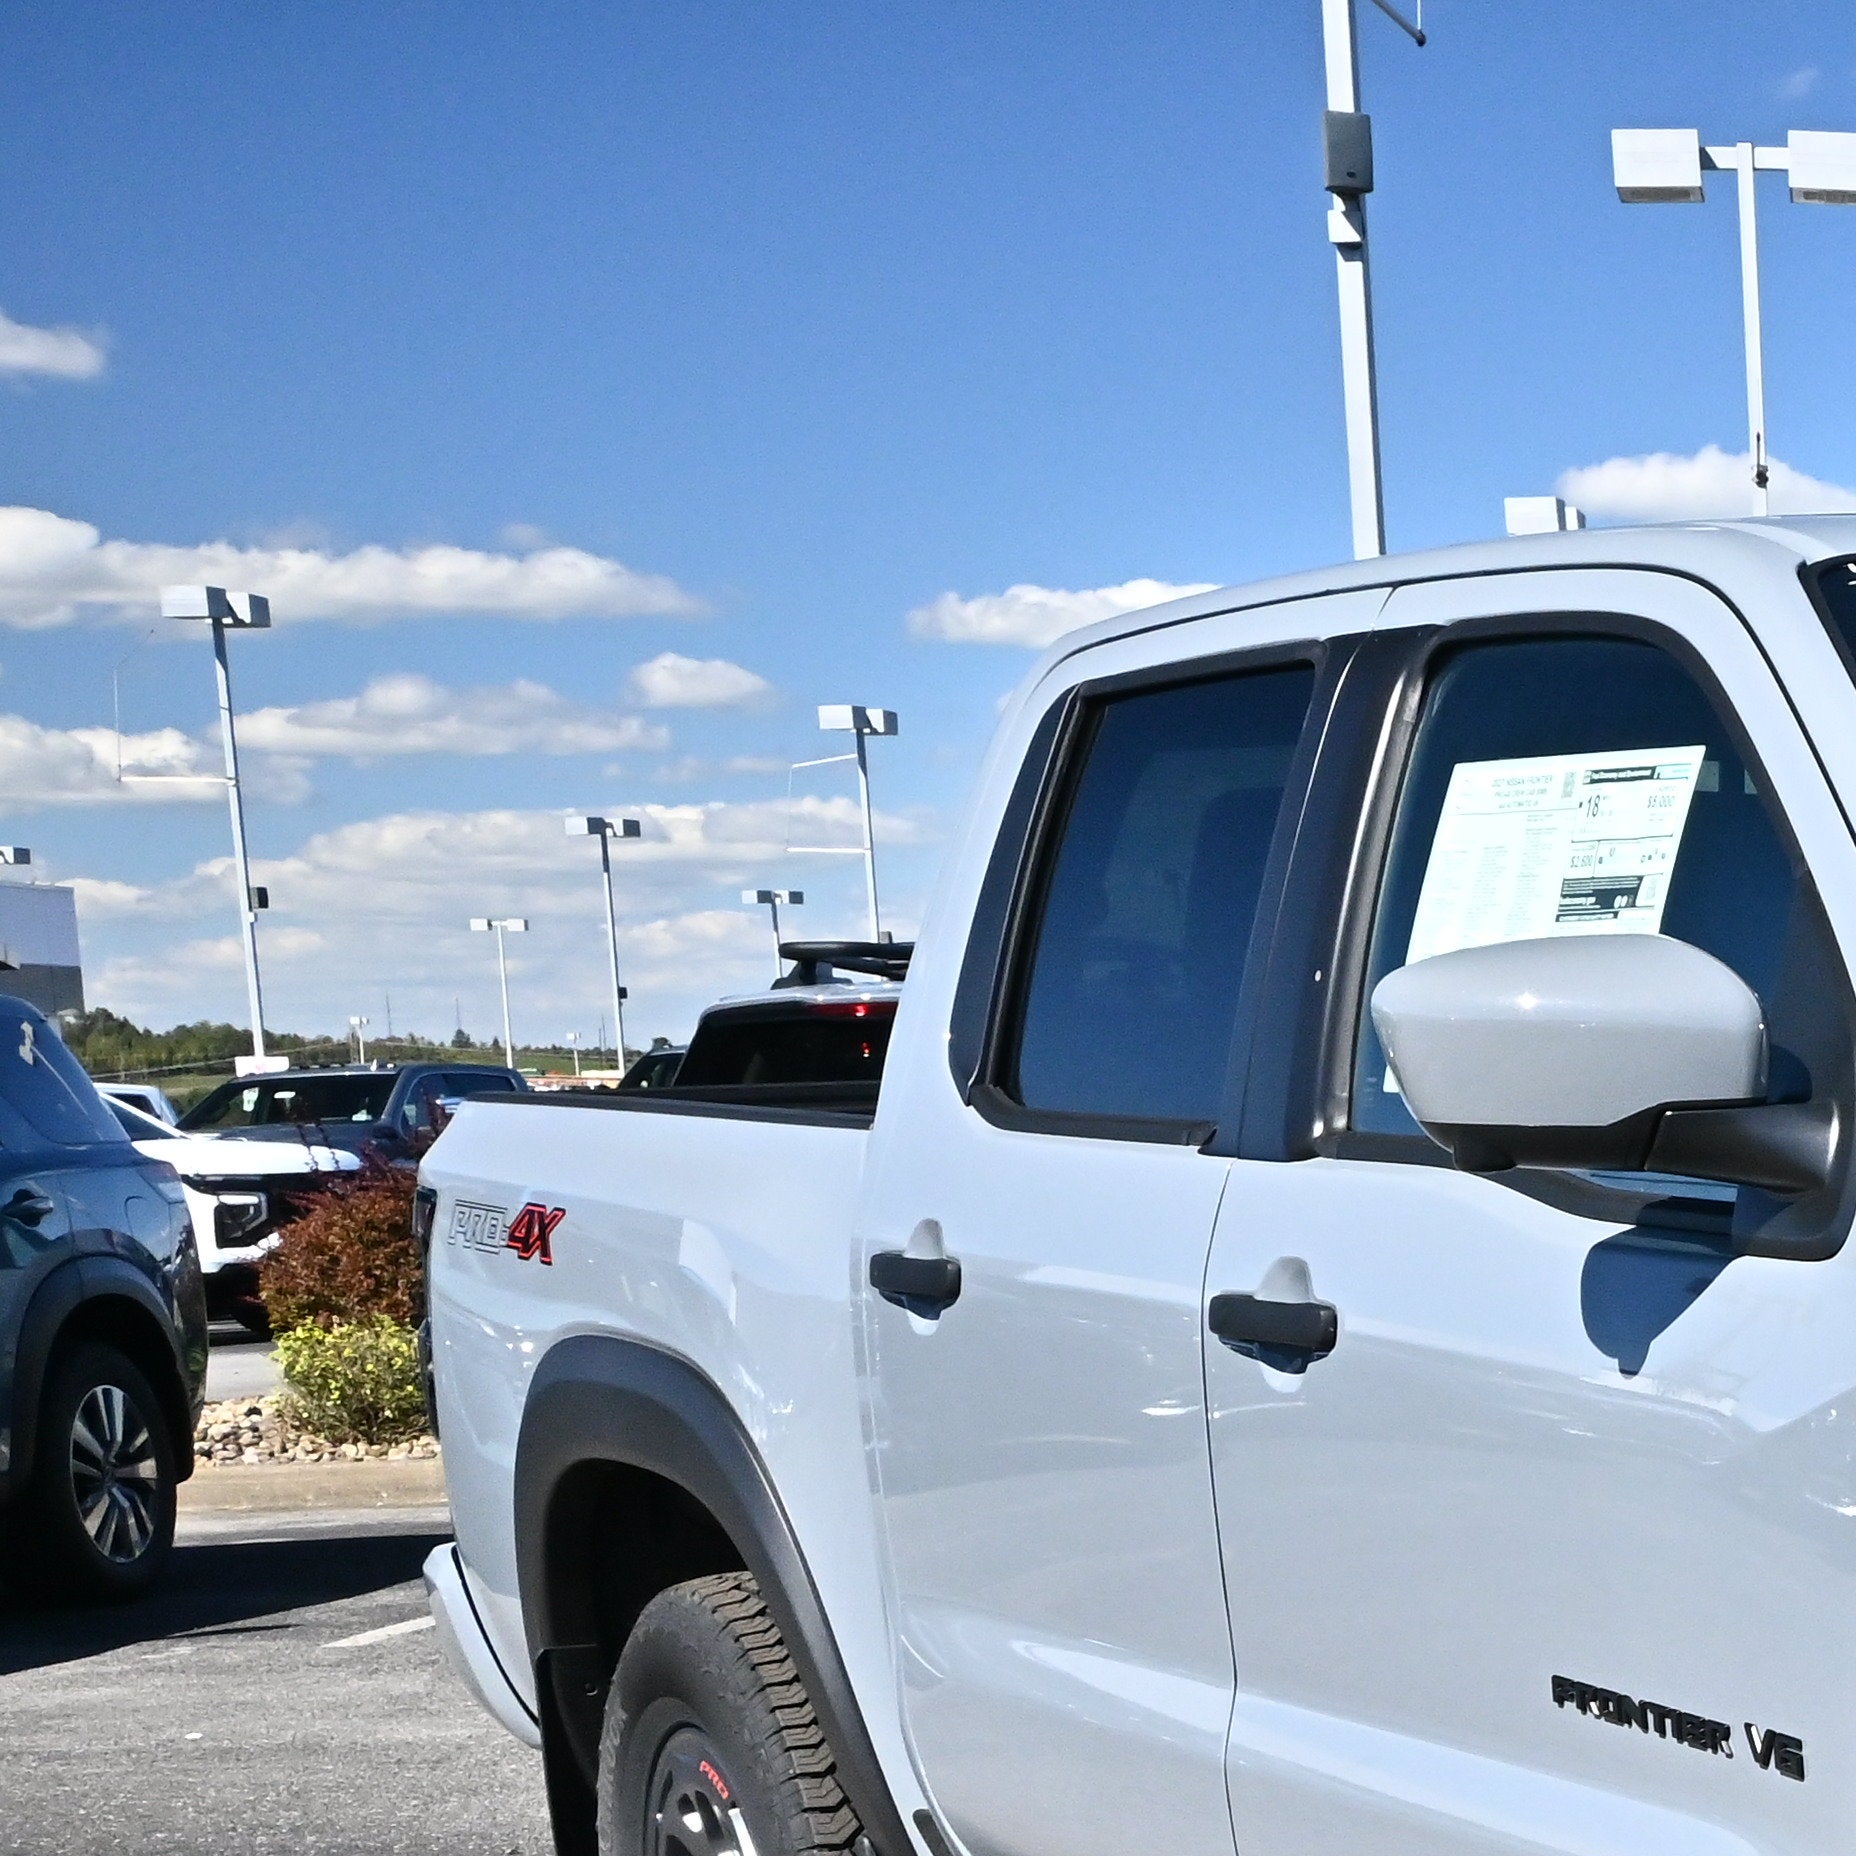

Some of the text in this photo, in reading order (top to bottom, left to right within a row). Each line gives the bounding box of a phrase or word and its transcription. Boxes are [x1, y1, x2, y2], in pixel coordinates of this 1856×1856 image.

[1551, 1674, 1806, 1783] FRONTIER V6
[699, 1760, 730, 1800] PRO
